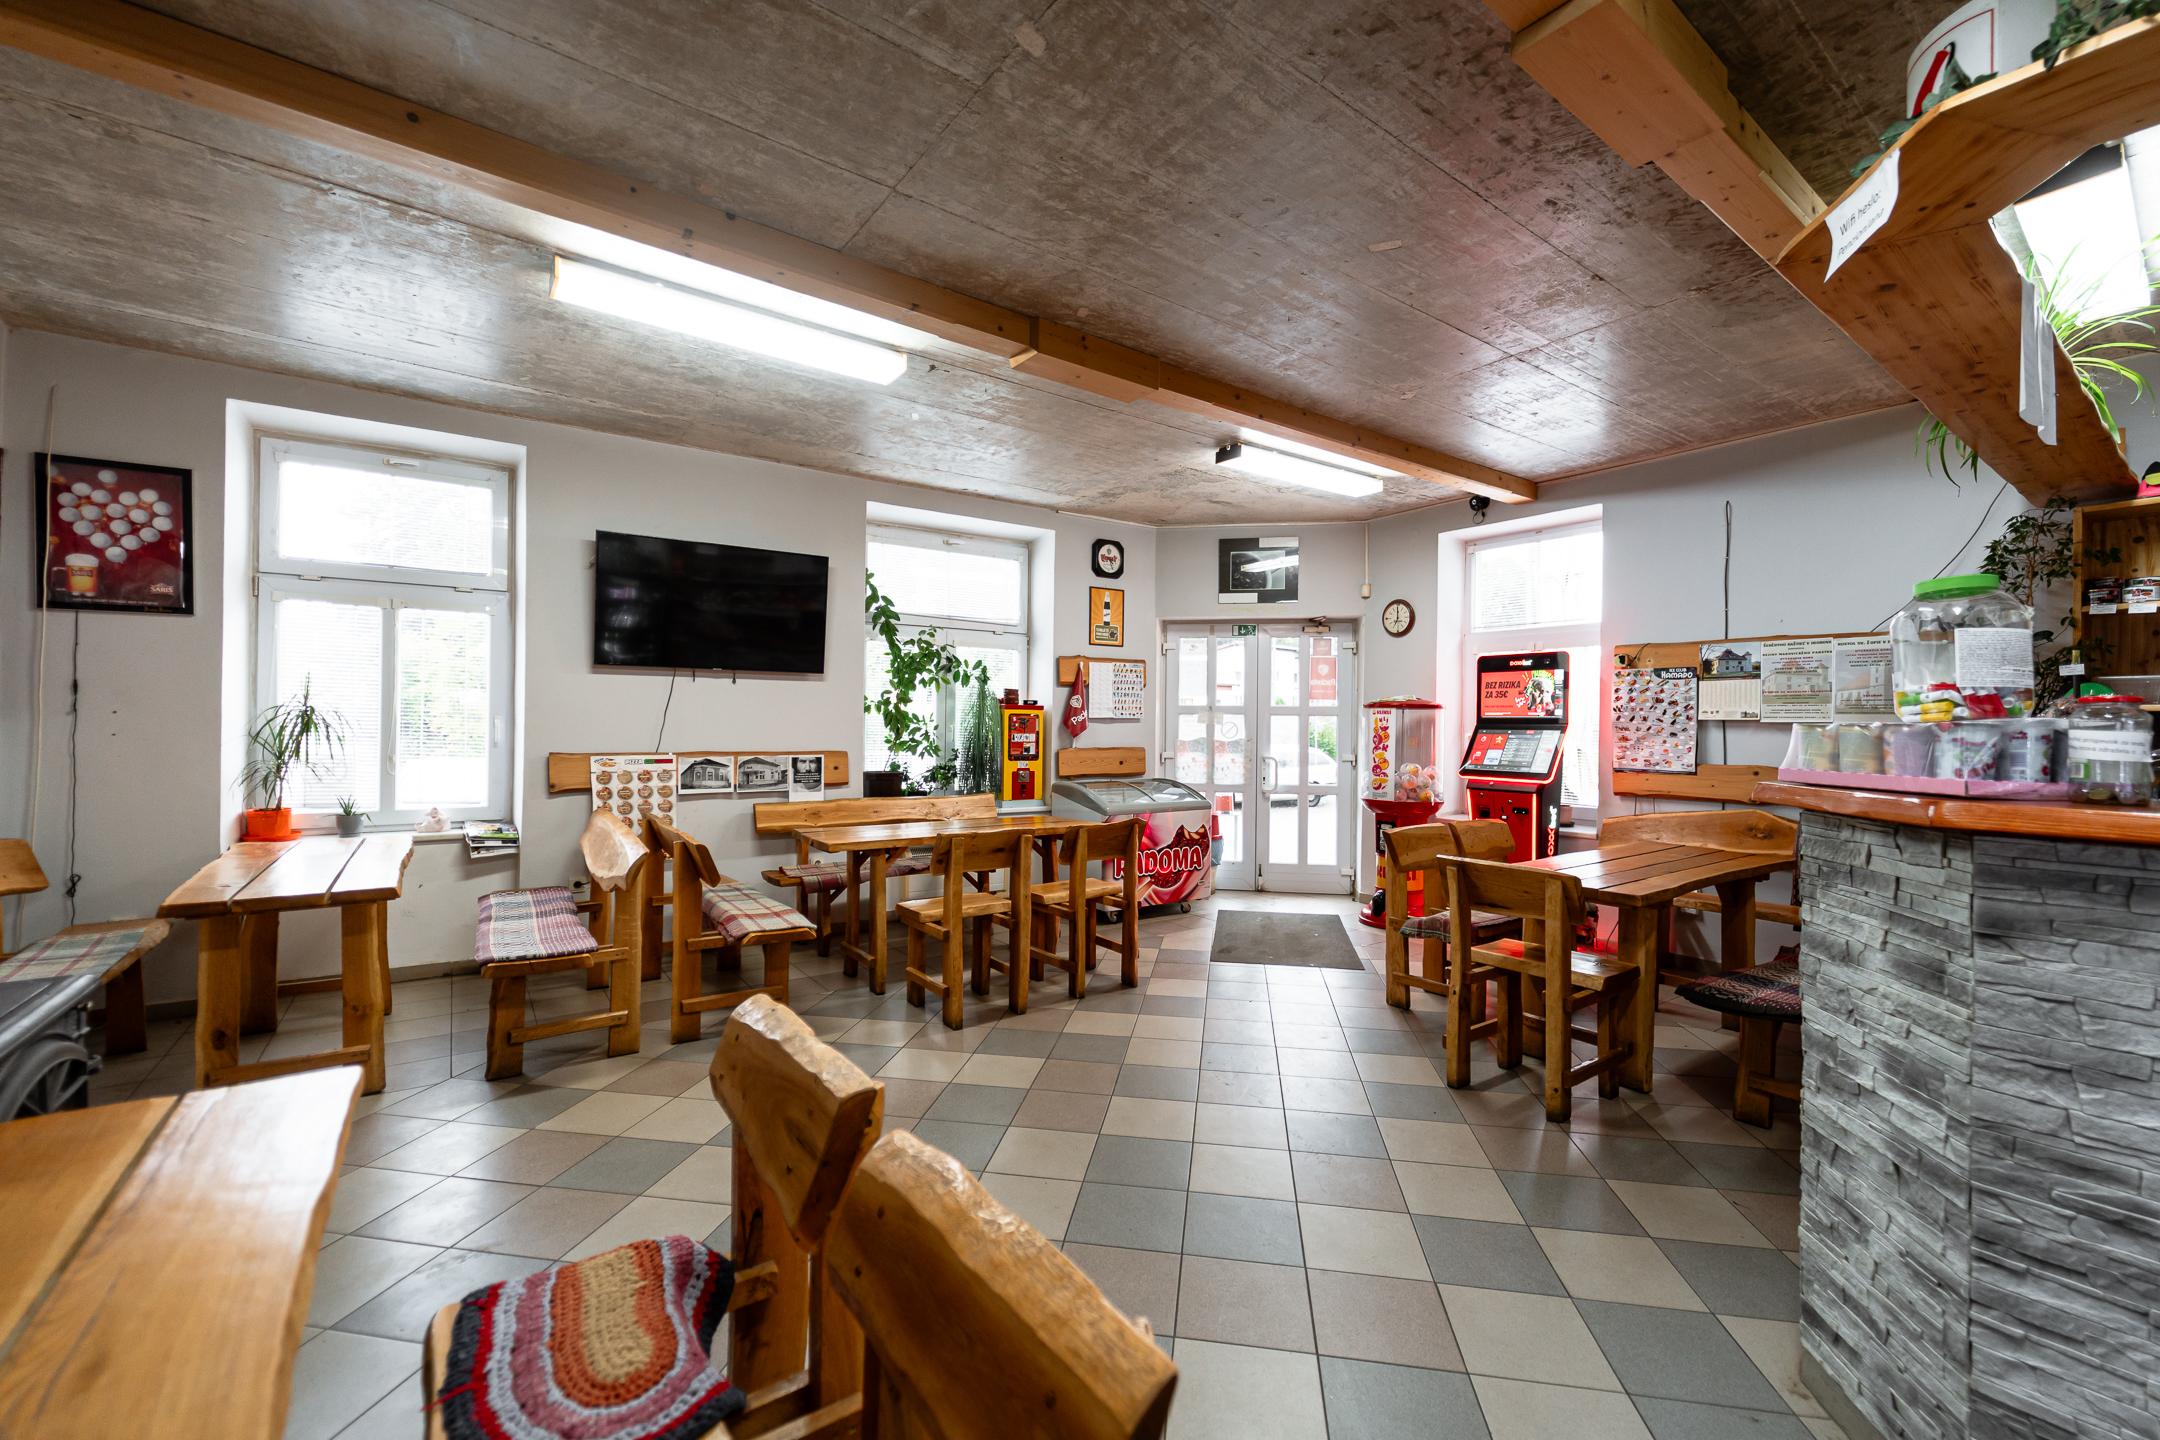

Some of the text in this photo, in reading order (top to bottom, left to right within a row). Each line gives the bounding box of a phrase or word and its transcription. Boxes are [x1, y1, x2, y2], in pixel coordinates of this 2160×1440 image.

[1839, 213, 1856, 236] Wifi
[1485, 680, 1521, 690] BEZ RIZIKA
[1485, 690, 1493, 698] ZA
